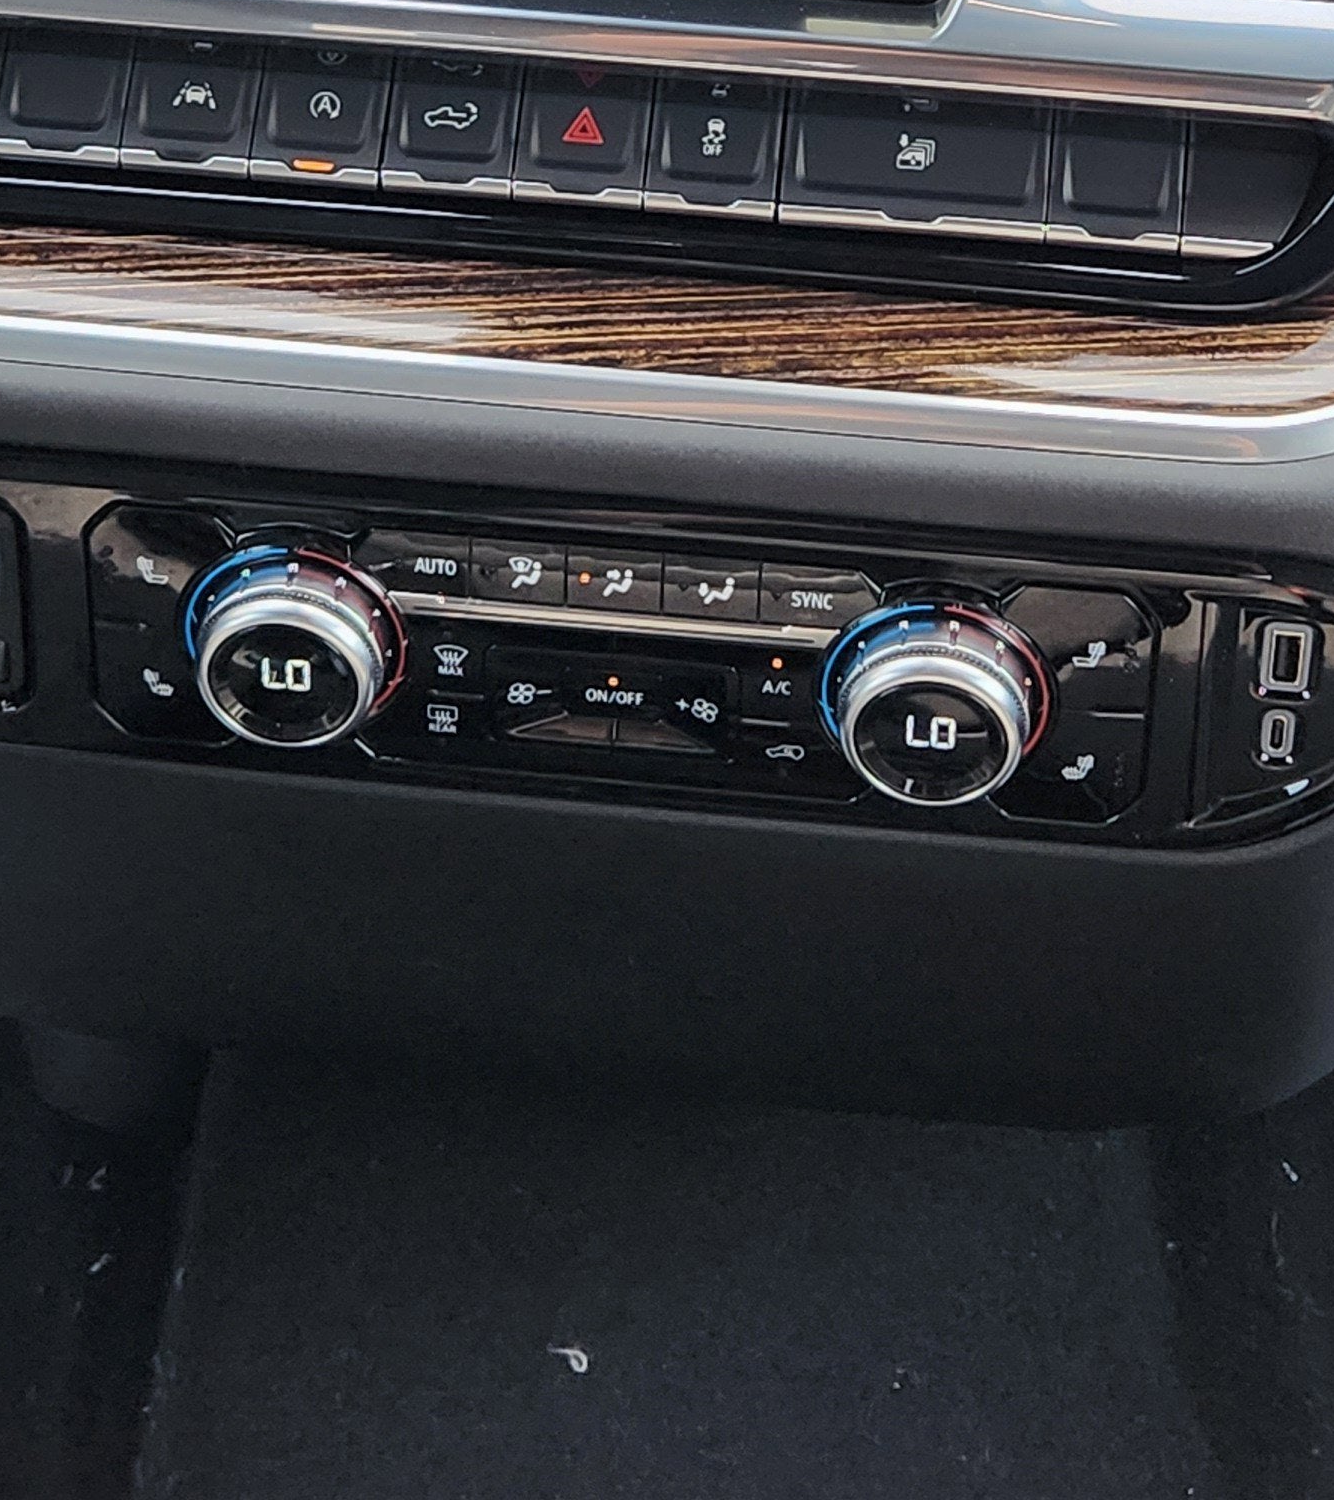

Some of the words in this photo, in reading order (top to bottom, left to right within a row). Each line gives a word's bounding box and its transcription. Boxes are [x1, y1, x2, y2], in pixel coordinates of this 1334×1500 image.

[702, 144, 723, 156] OFF
[413, 556, 458, 577] AUTO
[791, 591, 834, 612] SYNC
[261, 657, 312, 692] LO
[437, 665, 464, 678] MAX
[585, 688, 644, 706] ON/OFF
[762, 680, 792, 696] A/C
[428, 722, 457, 735] REAR
[905, 713, 958, 751] LO
